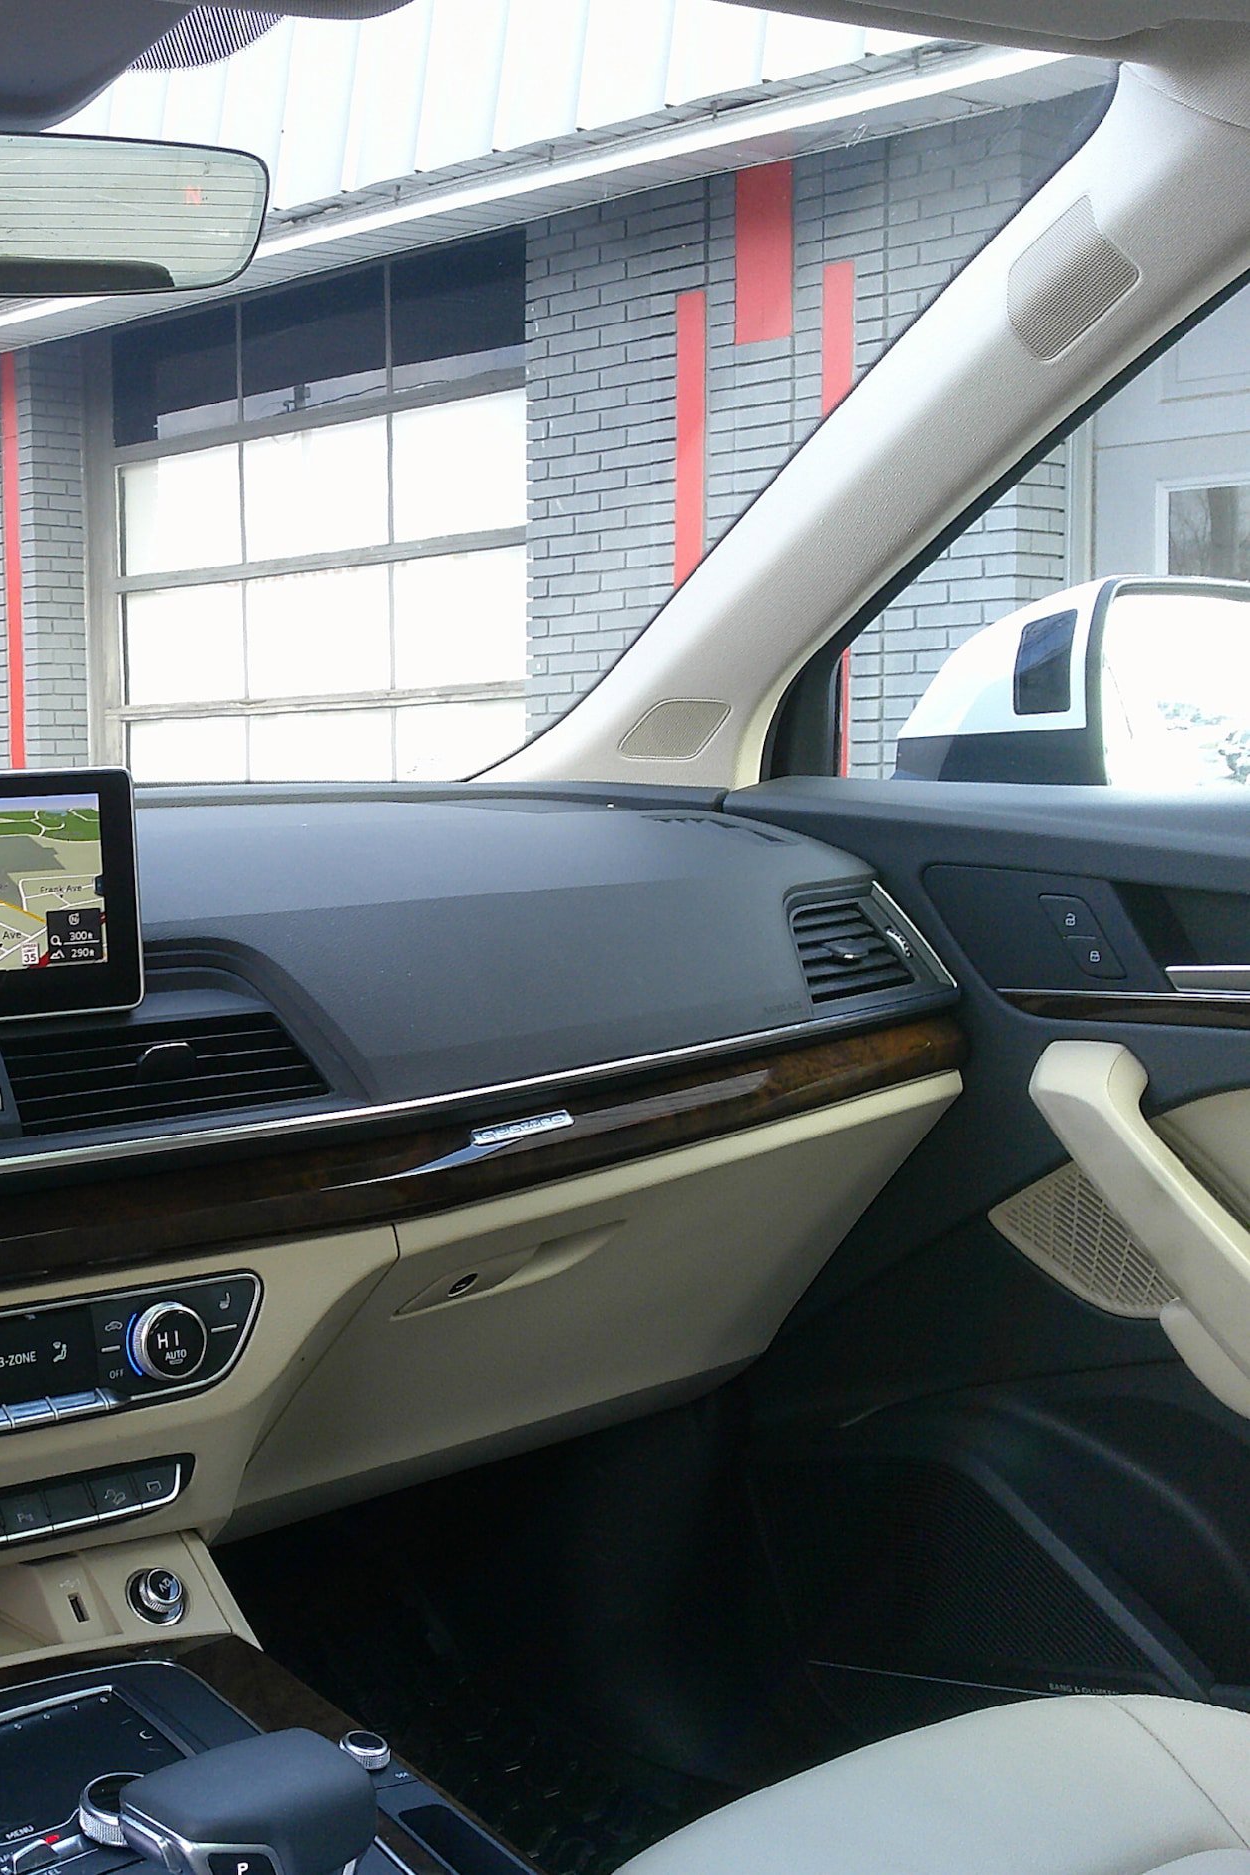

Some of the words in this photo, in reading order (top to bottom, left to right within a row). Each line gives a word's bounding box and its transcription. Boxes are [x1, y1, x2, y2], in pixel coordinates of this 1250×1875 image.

[66, 884, 82, 892] Ave
[2, 930, 22, 940] Ave
[23, 954, 38, 963] 35
[165, 1349, 188, 1361] AUTO
[110, 1368, 125, 1380] OFF
[5, 1825, 35, 1840] MENU
[237, 1863, 249, 1875] P
